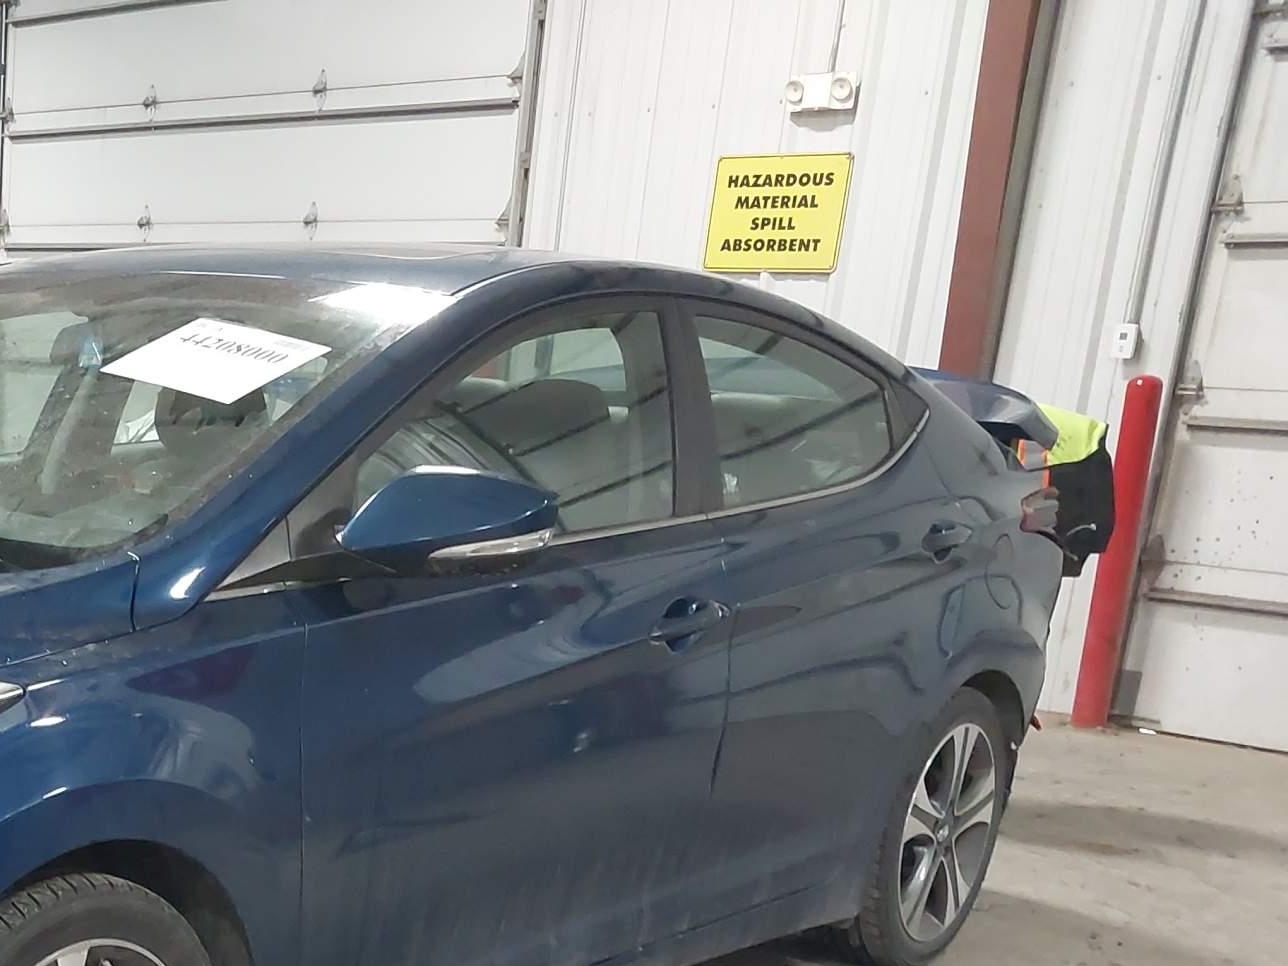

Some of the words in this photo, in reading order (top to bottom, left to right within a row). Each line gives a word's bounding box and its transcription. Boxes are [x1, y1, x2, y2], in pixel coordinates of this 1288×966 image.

[727, 172, 835, 189] HAZARDOUS
[734, 194, 819, 210] MATERIAL
[749, 216, 796, 231] SPILL
[719, 238, 821, 252] ABSORBENT
